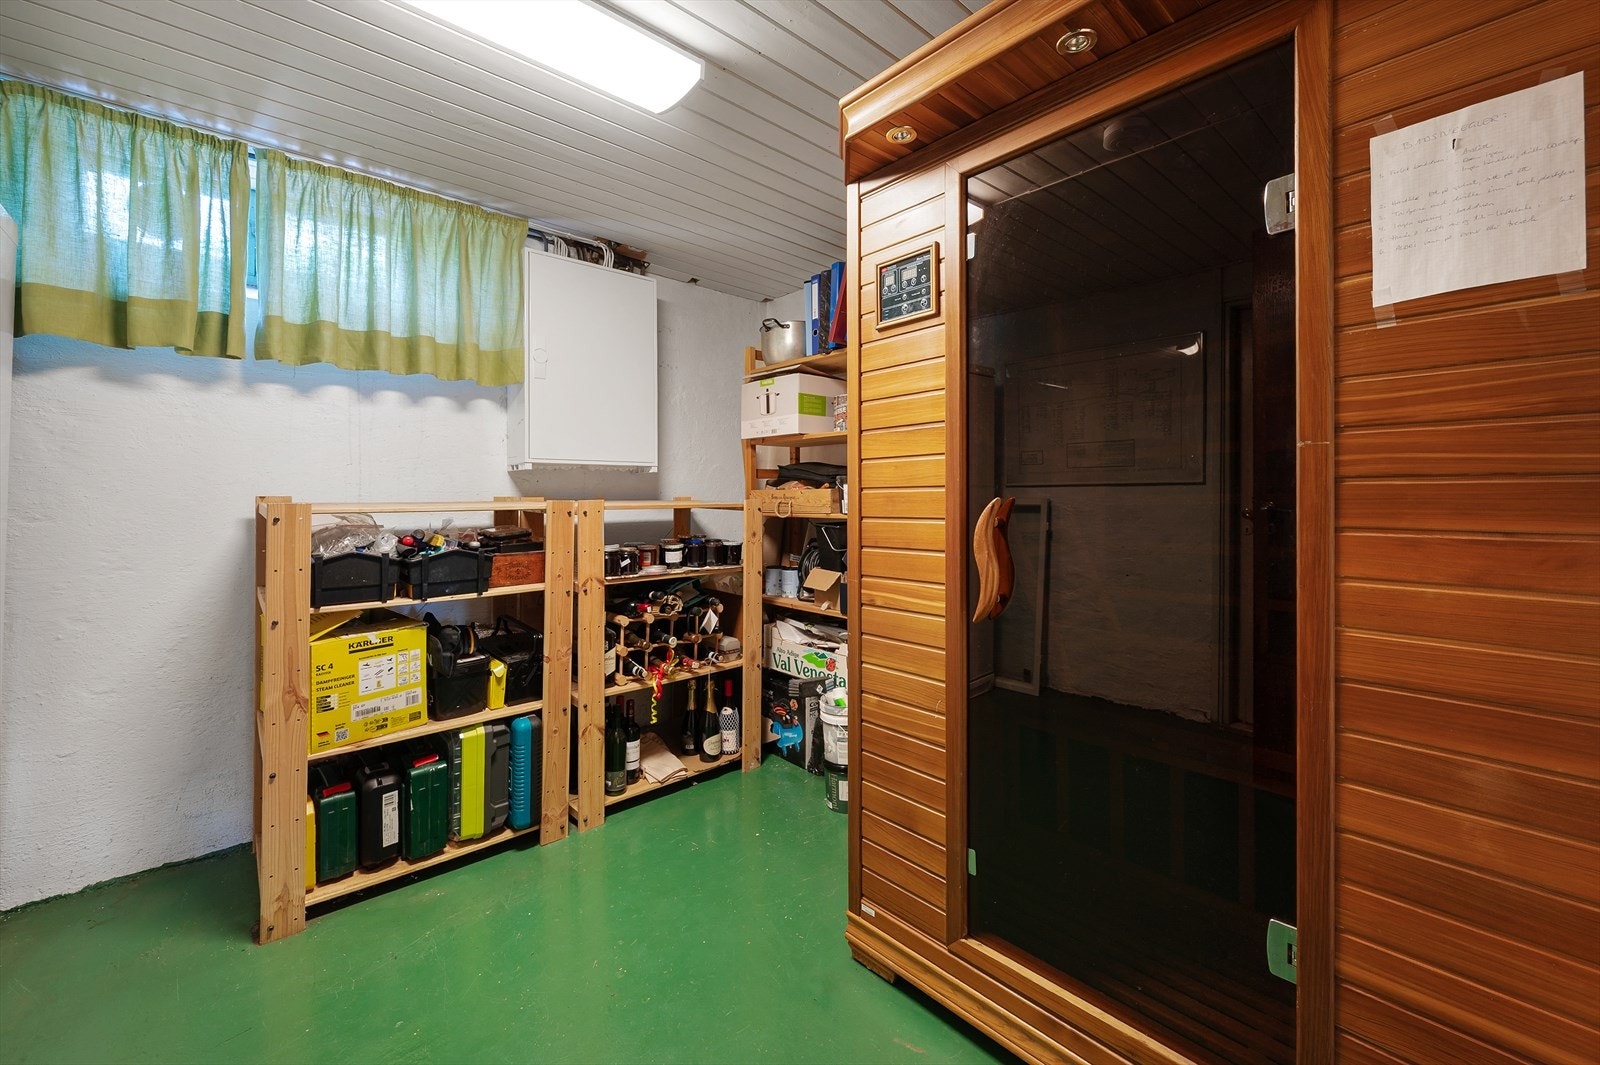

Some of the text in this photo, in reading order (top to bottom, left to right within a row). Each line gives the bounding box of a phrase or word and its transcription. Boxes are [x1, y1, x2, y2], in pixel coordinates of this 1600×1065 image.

[772, 652, 792, 673] Val
[316, 664, 326, 672] SC
[333, 680, 355, 689] CLEANER
